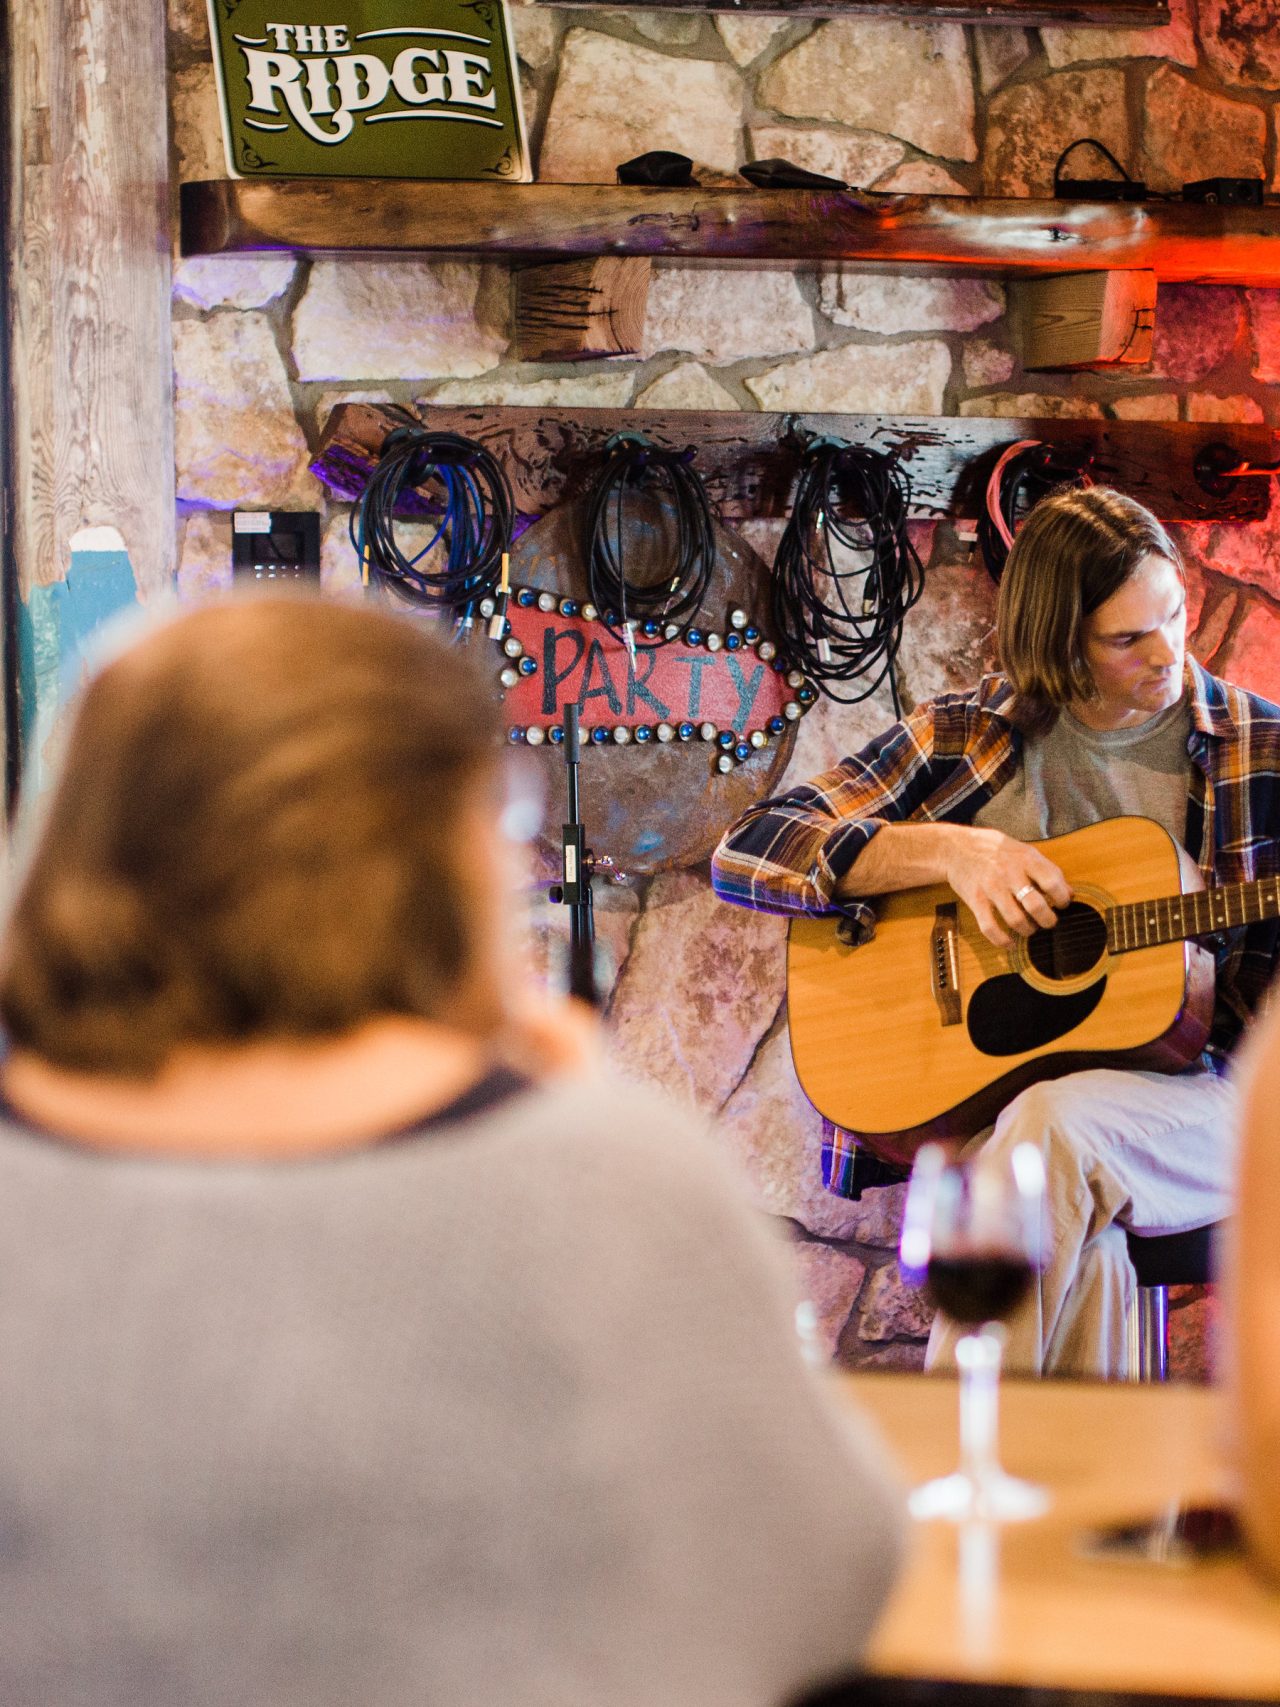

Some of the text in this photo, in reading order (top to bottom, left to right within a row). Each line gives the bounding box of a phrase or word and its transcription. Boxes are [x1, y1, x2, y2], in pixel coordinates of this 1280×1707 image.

[265, 23, 351, 53] THE
[241, 47, 497, 145] RIDGE
[541, 626, 765, 733] PARTY
